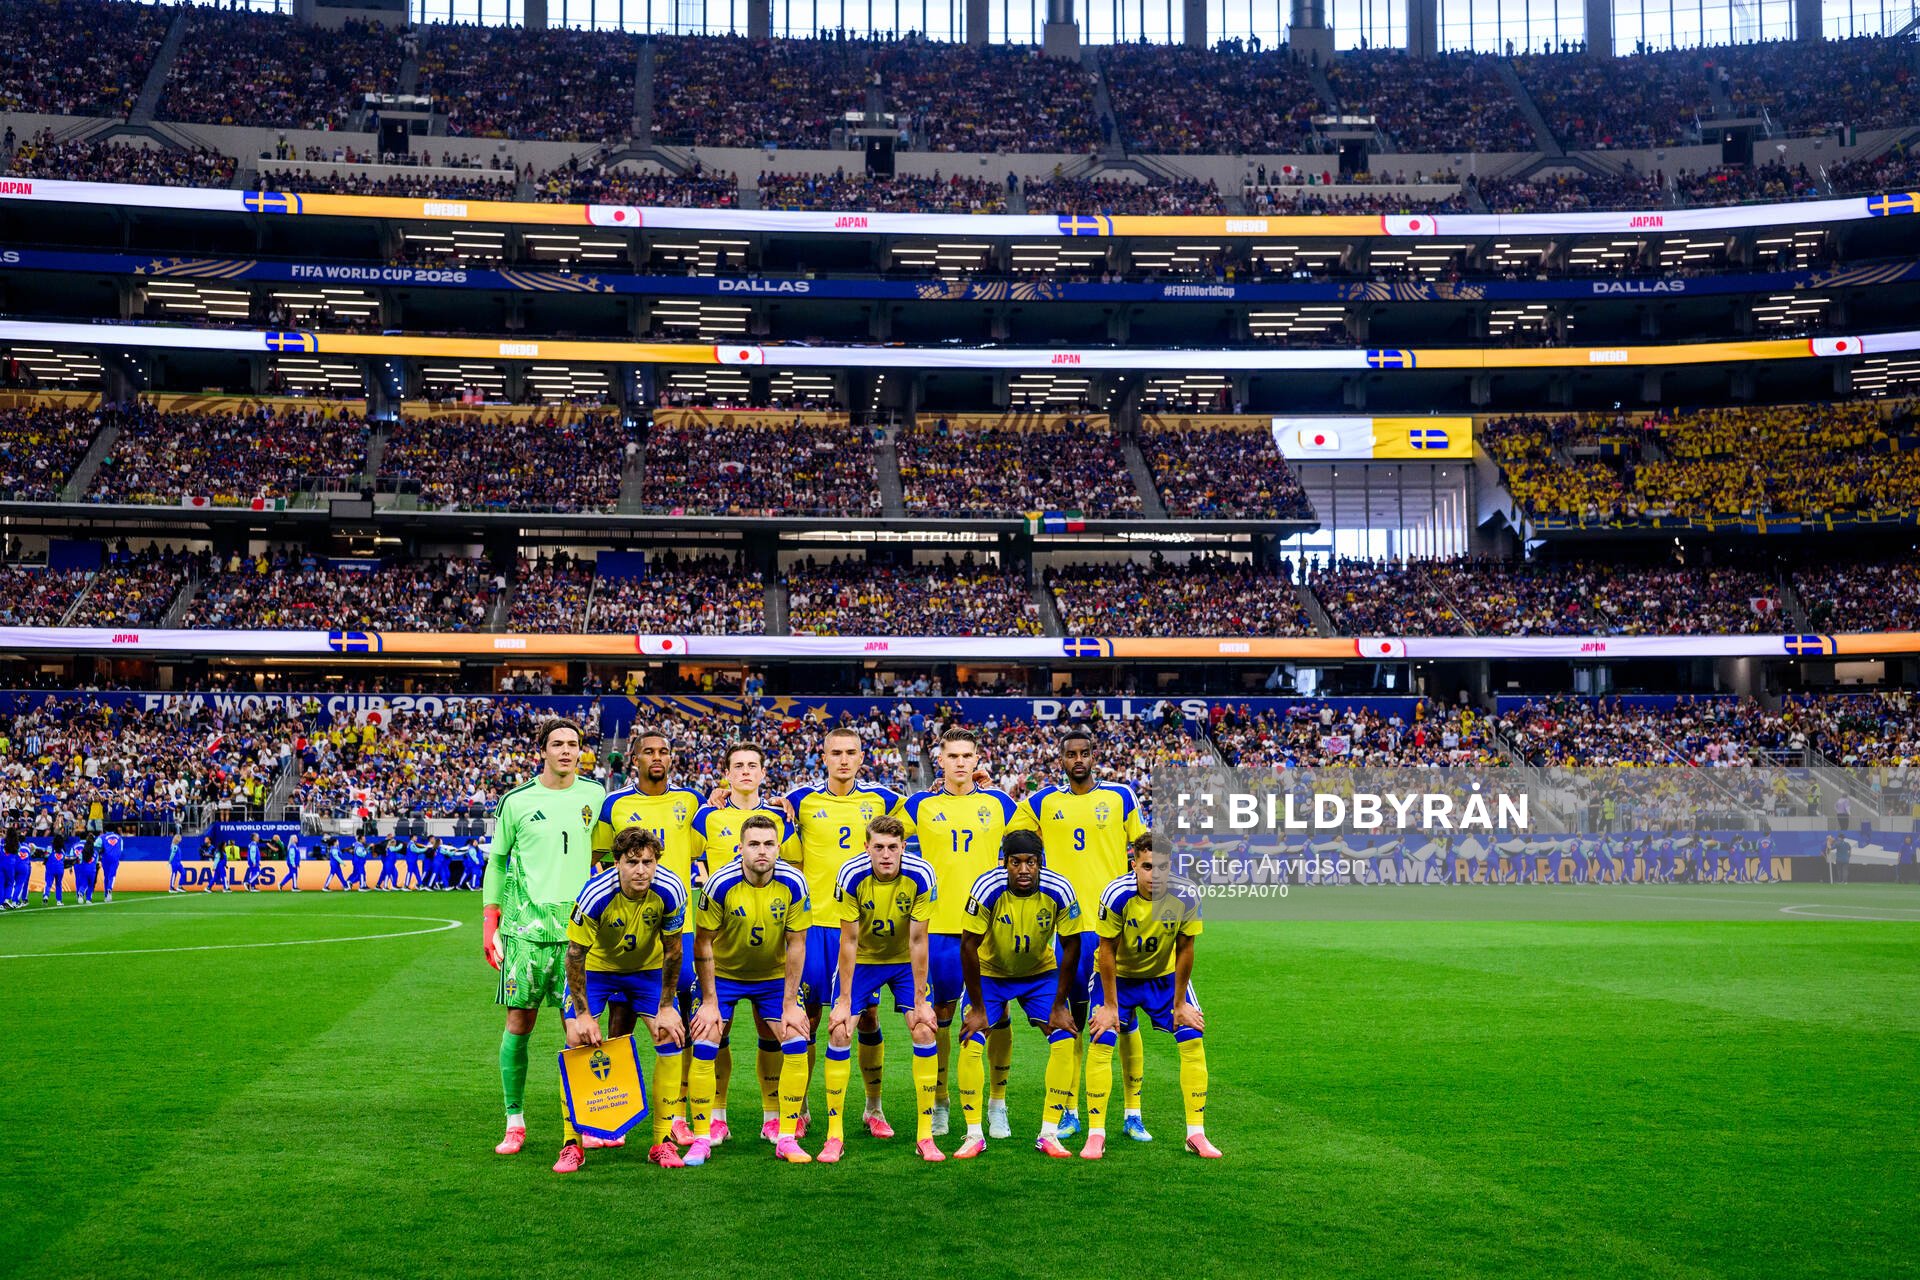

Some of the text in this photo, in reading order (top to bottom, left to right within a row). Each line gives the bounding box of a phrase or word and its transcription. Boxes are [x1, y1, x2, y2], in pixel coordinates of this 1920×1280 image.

[0, 182, 32, 195] APAN
[423, 202, 467, 217] SWEDEN
[835, 216, 868, 228] JAPAN
[1225, 220, 1268, 232] SWEDEN
[1630, 215, 1663, 227] JAPAN
[291, 264, 467, 283] FIFA WORLD CUP 2026
[718, 279, 810, 292] DALLAS
[1163, 285, 1235, 298] #FIFAWorldCup
[1592, 280, 1685, 293] DALLAS
[498, 343, 539, 357] SWEDEN
[1588, 350, 1628, 362] SWEDEN
[1051, 353, 1080, 364] JAPAN
[112, 634, 139, 643] JAPAN
[494, 638, 526, 649] SWEDEN
[864, 642, 889, 651] JAPAN
[1580, 643, 1606, 652] JAPAN
[220, 824, 301, 832] FIFA WORLD CUP 2026
[562, 830, 568, 855] 1
[839, 826, 851, 849] 2
[951, 829, 973, 852] 17
[1073, 828, 1085, 851] 9
[872, 919, 895, 937] 21
[623, 934, 637, 952] 3
[750, 927, 764, 947] 5
[1014, 934, 1030, 953] 11
[1136, 935, 1158, 953] 18
[603, 1086, 619, 1094] 2026
[586, 1098, 604, 1106] Japan
[607, 1092, 629, 1101] Sverige
[610, 1100, 629, 1108] Dallas
